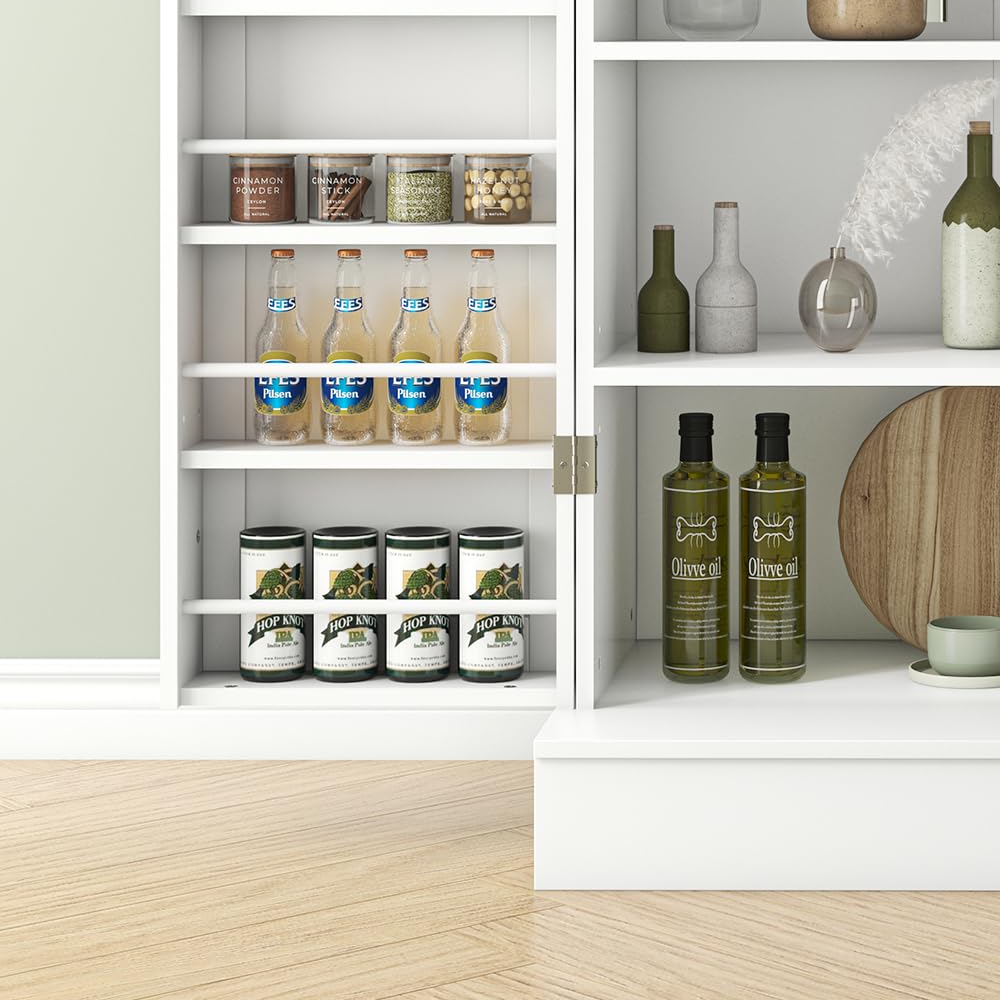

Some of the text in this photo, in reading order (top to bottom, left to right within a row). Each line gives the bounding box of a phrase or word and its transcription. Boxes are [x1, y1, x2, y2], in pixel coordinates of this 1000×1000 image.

[263, 388, 292, 399] Pilsen
[330, 388, 358, 399] Pilsen
[398, 388, 426, 399] Pilsen
[464, 388, 493, 399] Pilsen
[672, 556, 721, 577] Olivve oil
[748, 556, 798, 577] Olivve oil
[256, 616, 280, 632] HOP
[330, 616, 352, 632] HOP
[403, 616, 426, 632] HOP
[476, 616, 499, 632] HOP
